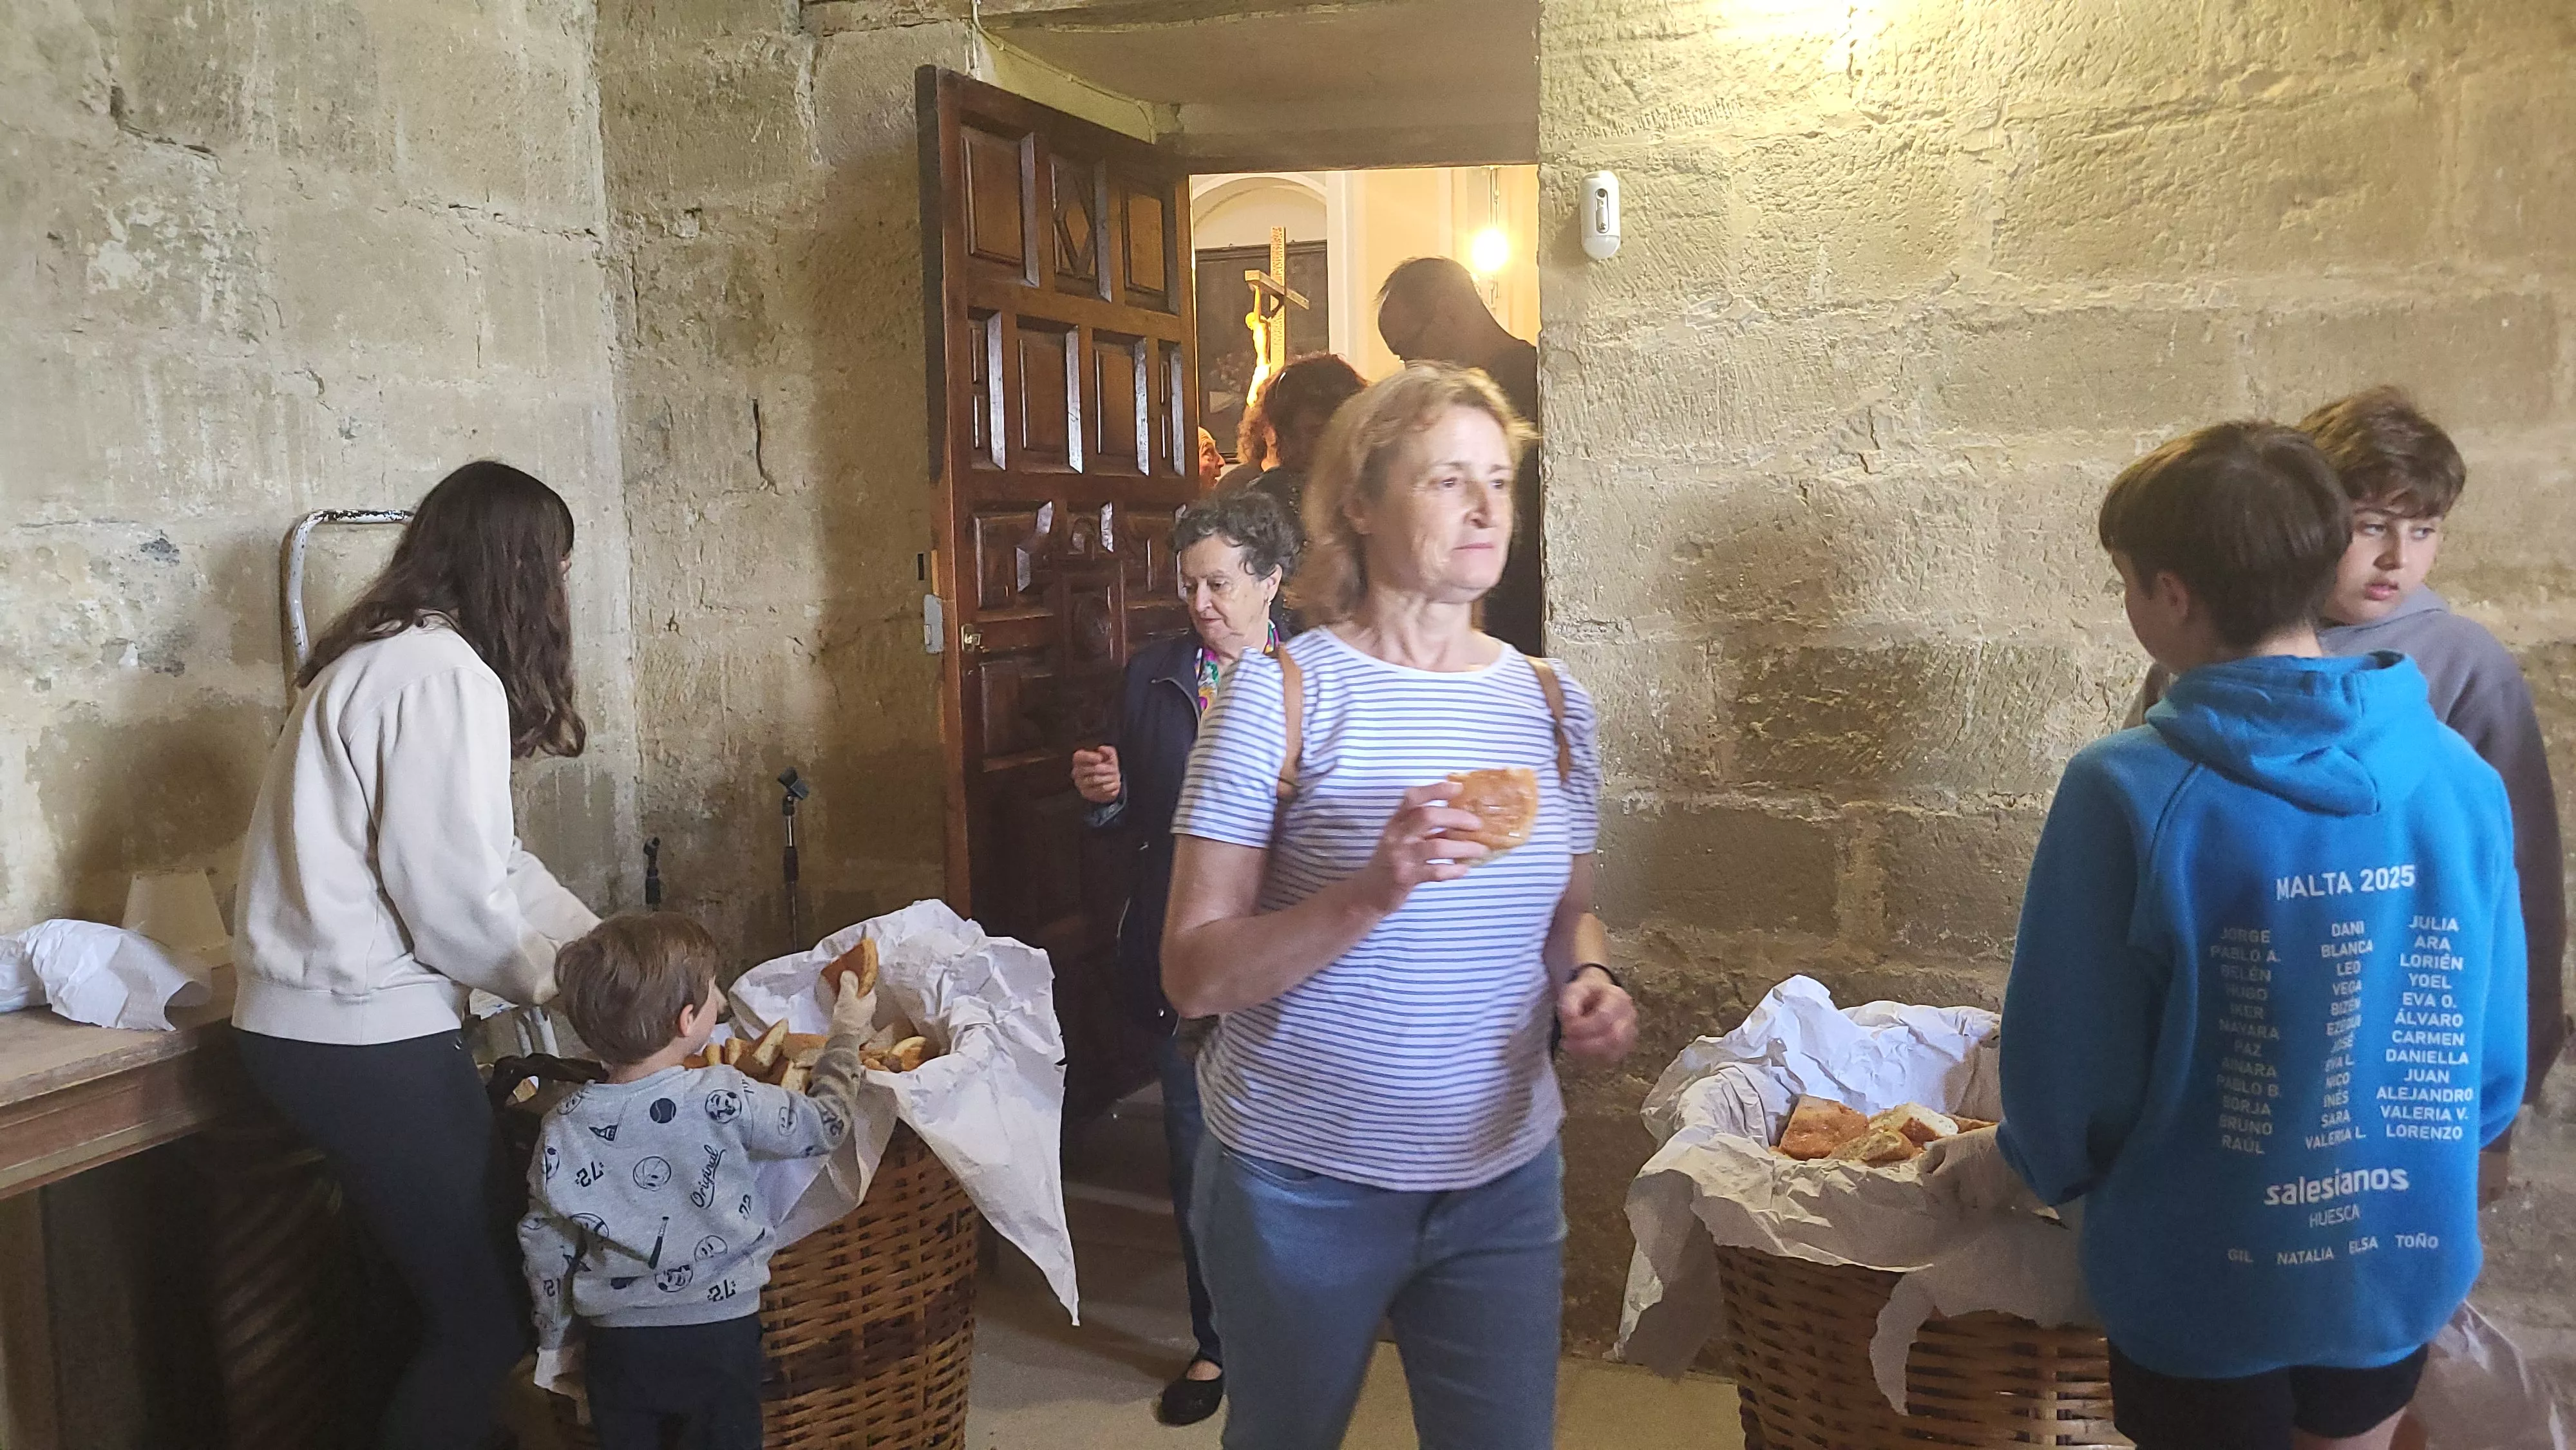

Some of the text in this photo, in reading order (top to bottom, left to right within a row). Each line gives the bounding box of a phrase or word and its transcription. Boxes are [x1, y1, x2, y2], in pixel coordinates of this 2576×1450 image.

[2277, 865, 2414, 900] MALTA 2025
[2331, 921, 2365, 937] DANI
[2408, 915, 2459, 932] JULIA
[2220, 927, 2271, 943] JORGE
[2415, 934, 2450, 952] ARA
[2210, 945, 2260, 962] PABLO
[2321, 939, 2373, 958] BLANCA
[2336, 961, 2362, 976] LEO
[2400, 952, 2463, 970] LORIÉN
[2333, 979, 2362, 995] VEGA
[2408, 973, 2452, 989] YOEL
[2403, 992, 2457, 1008] EVA O.
[2394, 1008, 2463, 1028] ÁLVARO
[2392, 1030, 2465, 1046] CARMEN
[2385, 1049, 2469, 1065] DANIELLA
[2216, 1074, 2262, 1095] PABLO
[2403, 1069, 2450, 1083] JUAN
[2376, 1086, 2474, 1102] ALEJANDRO
[2321, 1109, 2350, 1127] SARA
[2380, 1106, 2468, 1120] VALERIA V.
[2219, 1113, 2273, 1135] BRUNO
[2386, 1124, 2463, 1140] LORENZO
[2305, 1128, 2351, 1149] VALERIA
[690, 1144, 726, 1209] Original
[2264, 1167, 2410, 1205] salesianos
[2309, 1203, 2360, 1228] HUESCA
[2228, 1232, 2439, 1265] GIL NATALIA ELSA TOÑO
